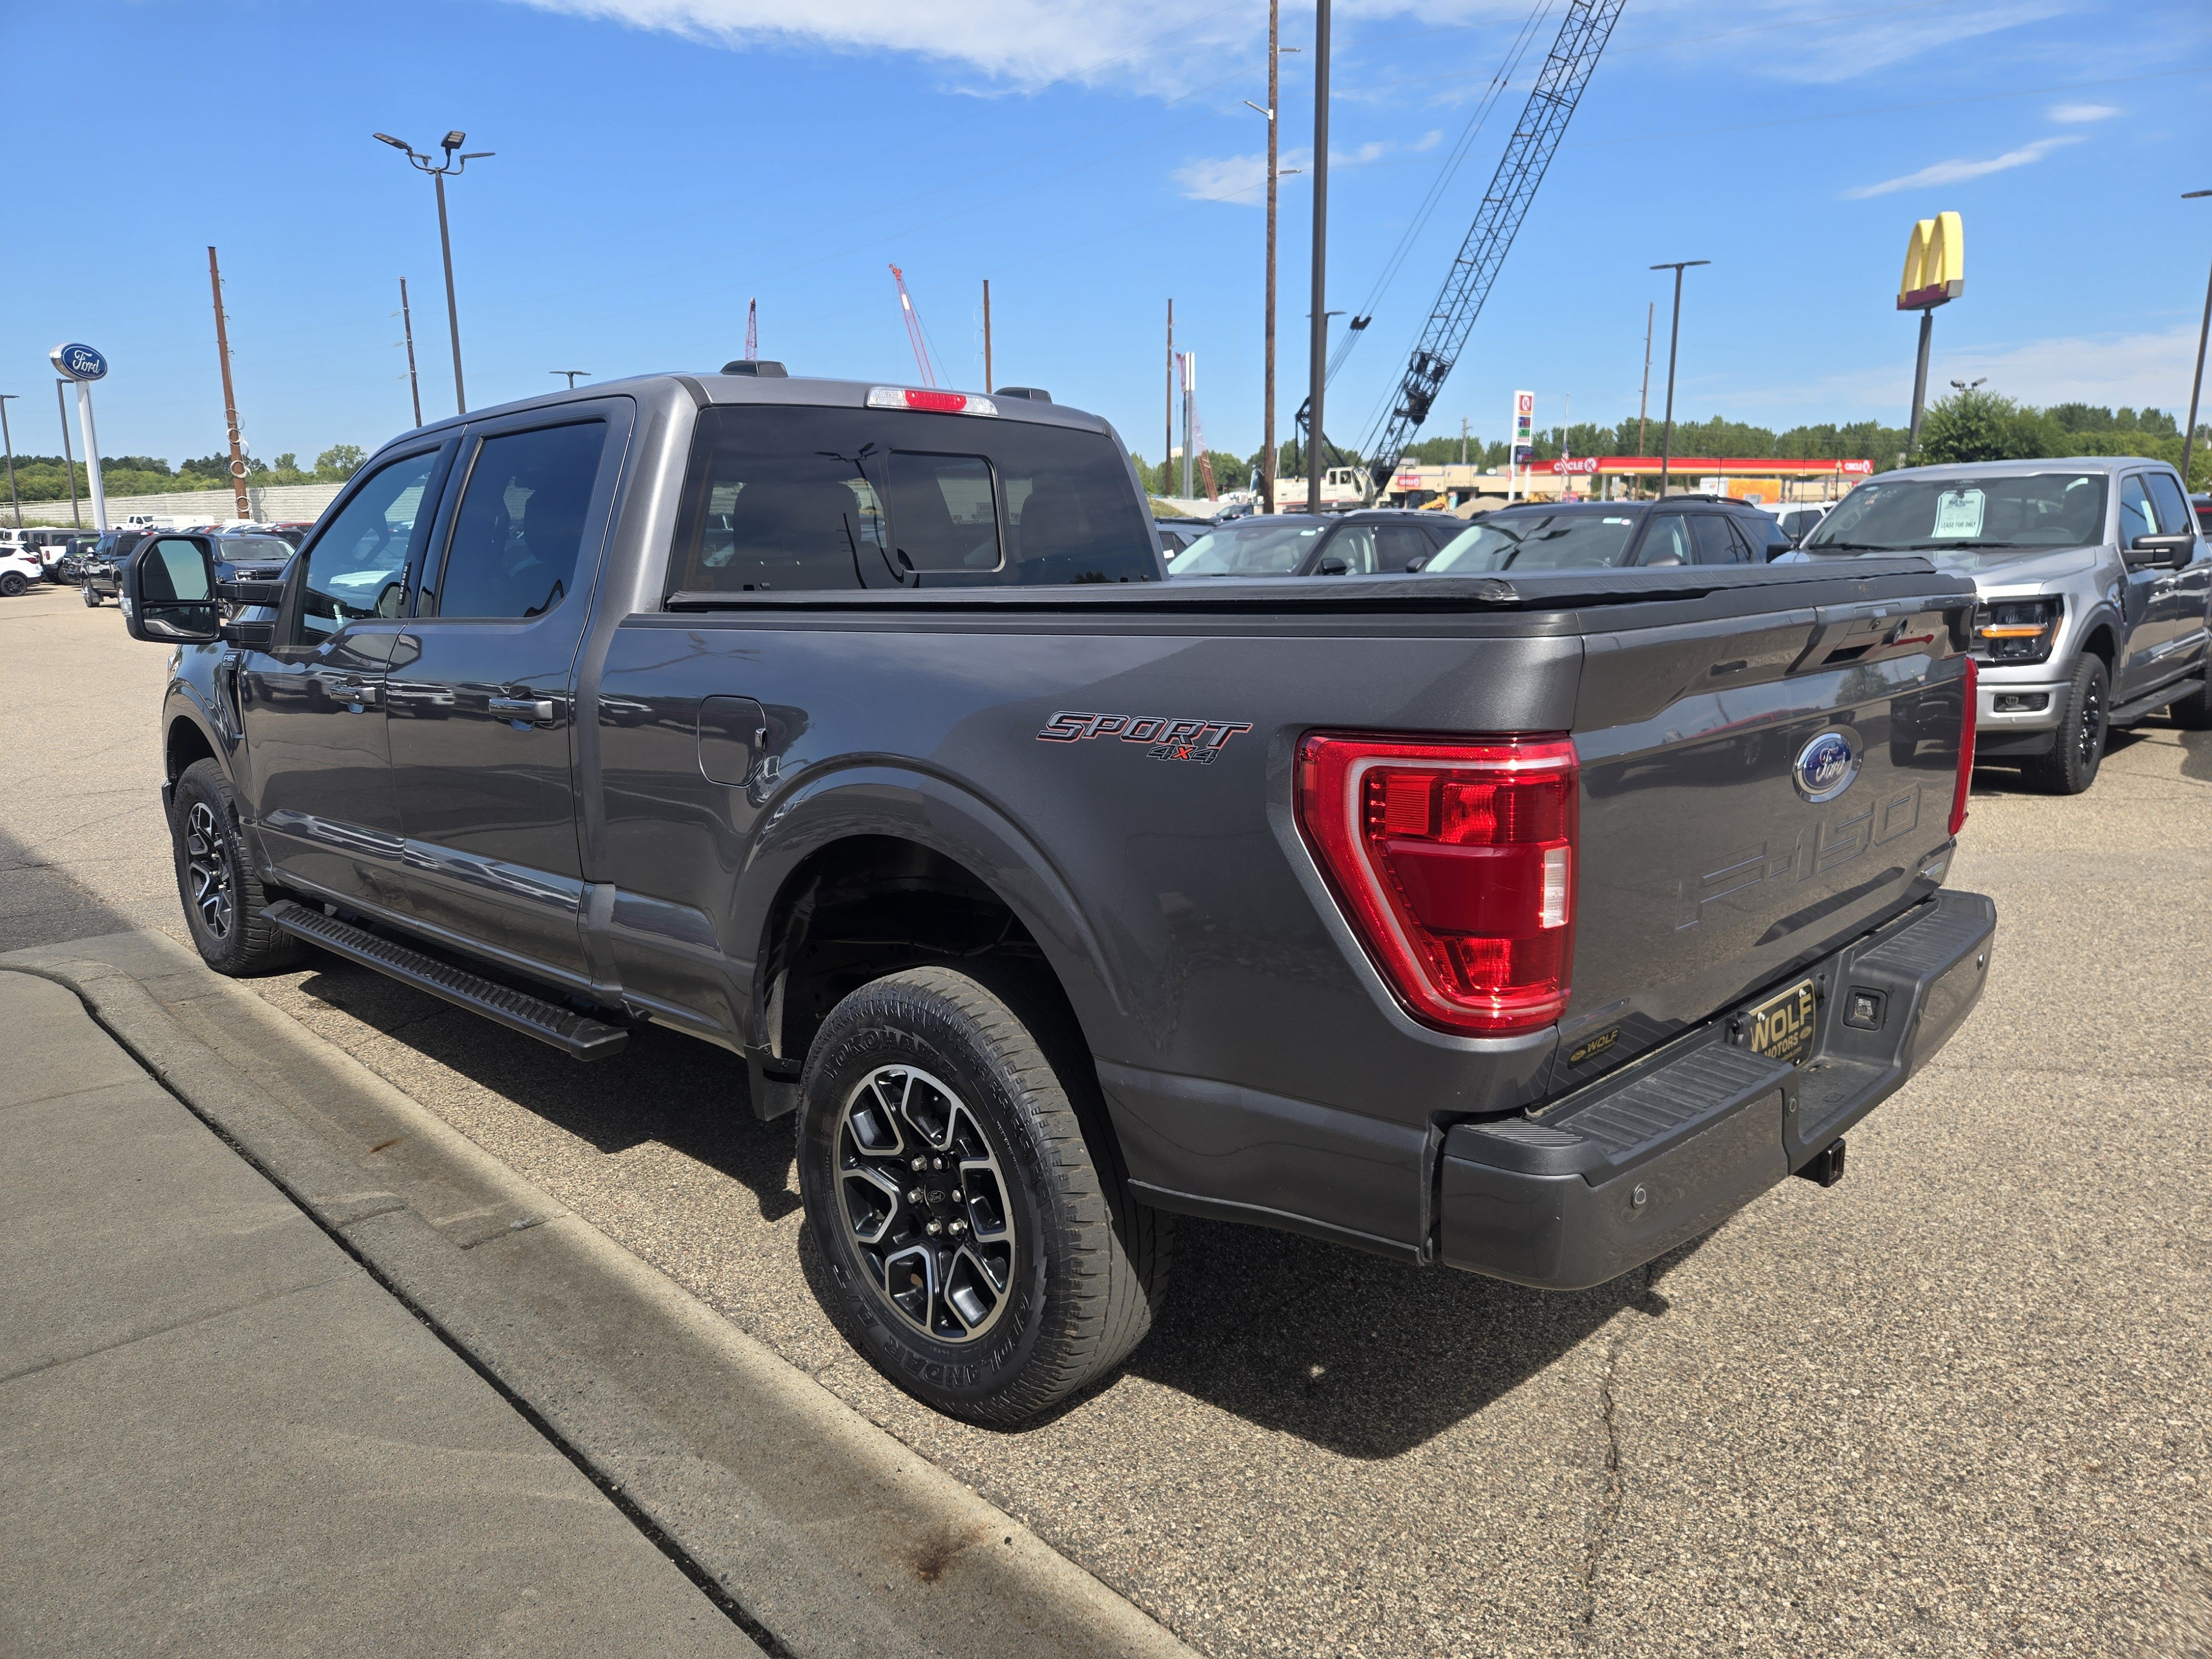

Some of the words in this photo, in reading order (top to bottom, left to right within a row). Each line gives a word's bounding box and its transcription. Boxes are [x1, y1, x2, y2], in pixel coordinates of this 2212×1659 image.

[72, 350, 100, 374] Ford
[1554, 461, 1583, 471] CCLE
[1585, 458, 1596, 472] K
[1863, 460, 1870, 473] K
[1036, 711, 1253, 749] SPORT
[1815, 747, 1846, 782] Ford
[1676, 782, 1922, 931] F-150
[1750, 993, 1812, 1052] WOLF
[1587, 1030, 1619, 1052] WOLF
